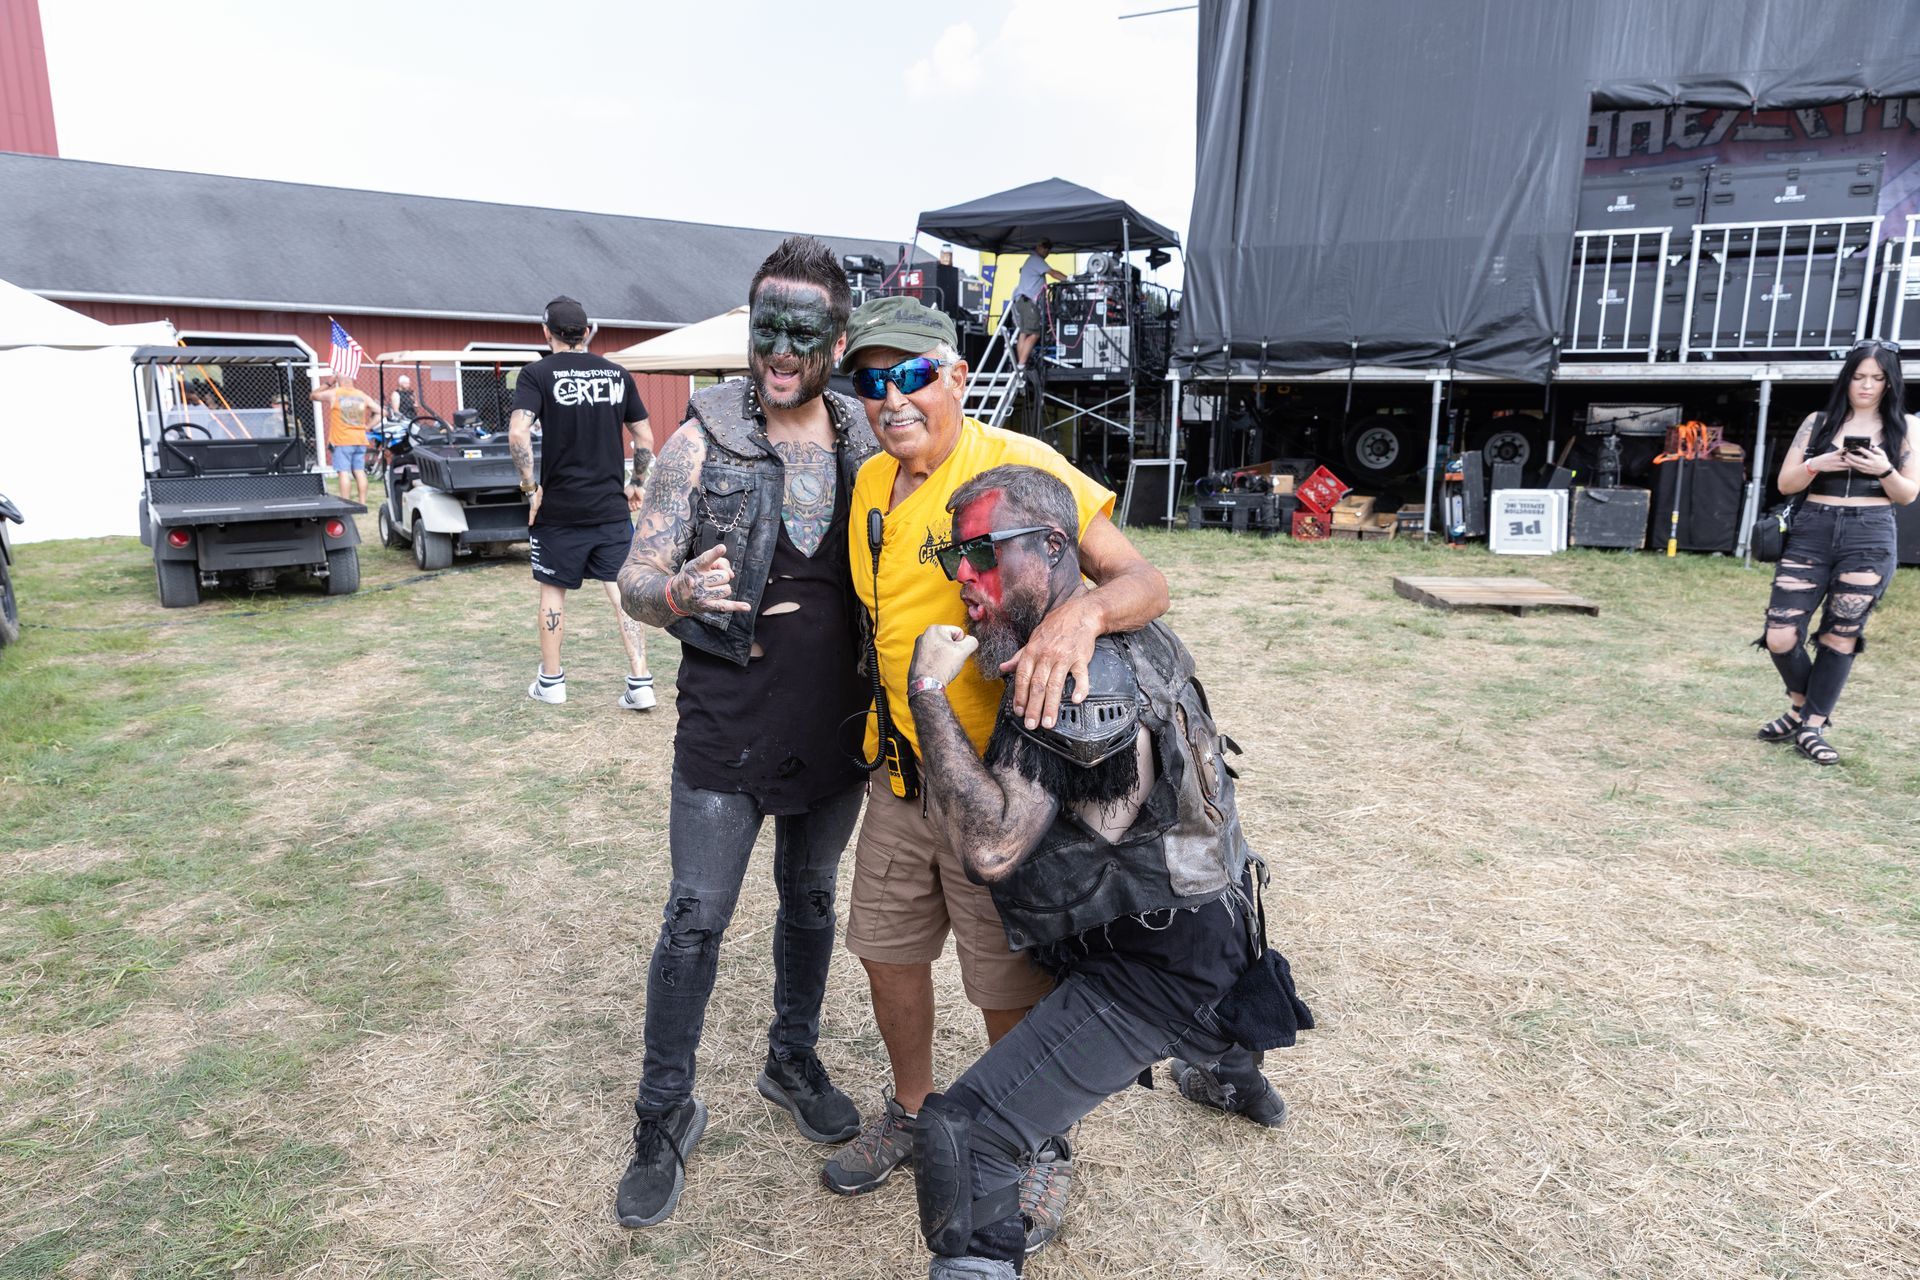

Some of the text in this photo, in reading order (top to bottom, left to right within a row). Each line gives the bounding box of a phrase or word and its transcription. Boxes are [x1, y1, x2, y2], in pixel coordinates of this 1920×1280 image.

[901, 272, 920, 288] PE
[553, 378, 625, 406] CREW
[1509, 520, 1541, 535] PE
